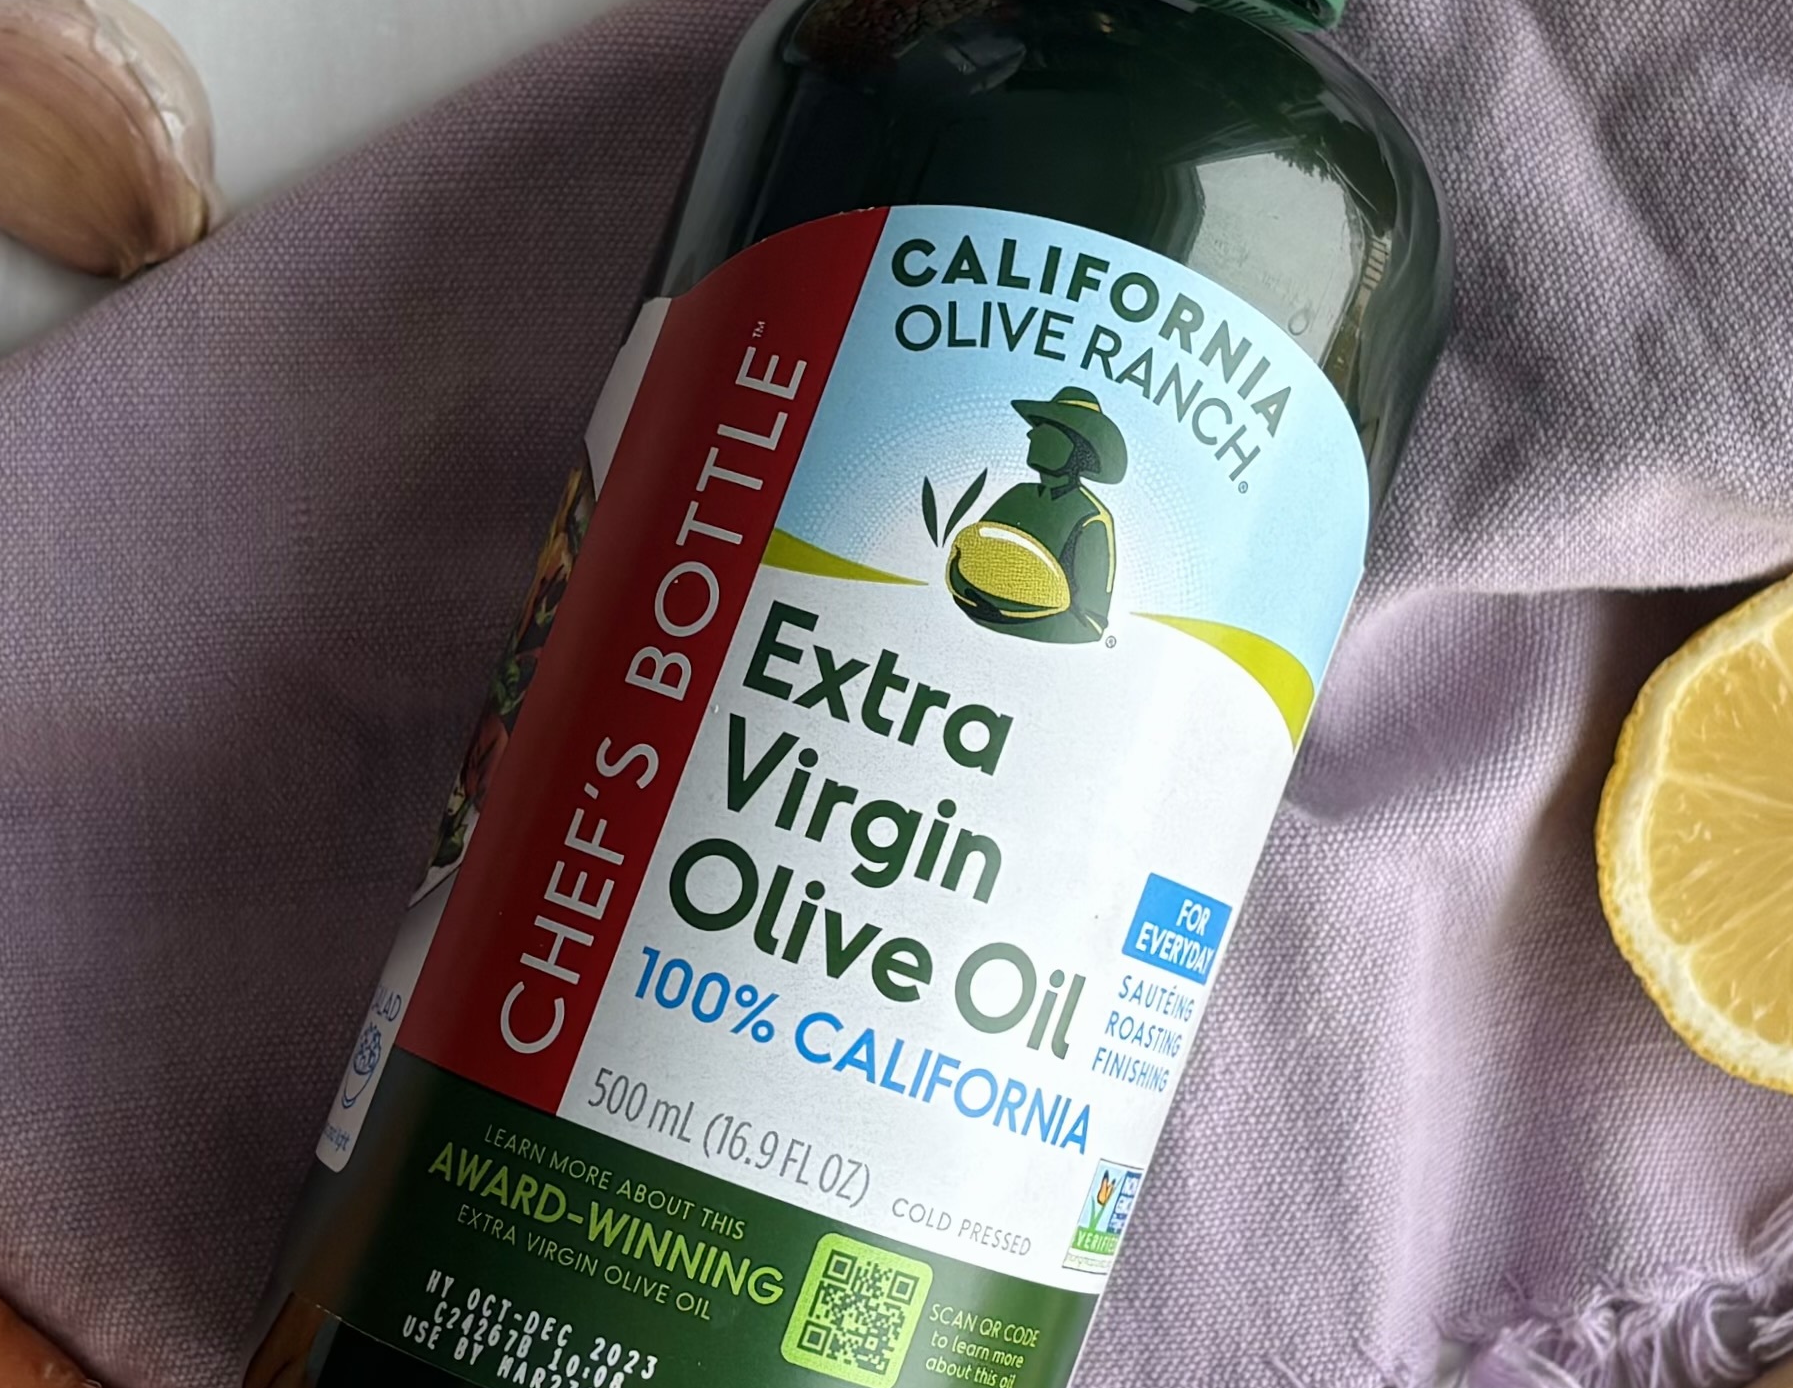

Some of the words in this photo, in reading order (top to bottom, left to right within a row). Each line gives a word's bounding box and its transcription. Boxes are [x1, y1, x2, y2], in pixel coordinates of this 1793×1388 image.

[891, 235, 1291, 437] CALIFORNIA
[895, 301, 1074, 361] OLIVE
[1080, 324, 1261, 482] RANCH
[743, 600, 1014, 776] Extra
[727, 712, 1002, 904] Virgin
[500, 737, 659, 1054] CHEF'S
[1176, 899, 1210, 936] FOR
[669, 838, 933, 1002] Olive
[954, 942, 1086, 1059] Oil
[1136, 921, 1214, 975] EVERYDAY
[1105, 1011, 1182, 1058] ROASTING
[1119, 975, 1194, 1022] SAUTÉING
[634, 946, 780, 1043] 100%
[795, 1012, 1090, 1154] CALIFORNIA
[1092, 1047, 1169, 1092] FINISHING
[485, 1124, 546, 1164] LEARN
[550, 1150, 612, 1190] MORE
[616, 1179, 694, 1220] ABOUT
[703, 1208, 746, 1240] THIS
[588, 1068, 648, 1121] 500
[648, 1098, 695, 1143] mL
[703, 1112, 778, 1169] (16.9
[780, 1138, 810, 1187] FL
[819, 1153, 871, 1208] OZ)
[428, 1142, 784, 1304] AWARD-WINNING
[458, 1205, 517, 1246] EXTRA
[527, 1232, 598, 1277] VIRGIN
[605, 1265, 667, 1303] OLIVE
[675, 1293, 712, 1320] OIL
[892, 1198, 951, 1231] COLD
[958, 1219, 1031, 1256] PRESSED
[403, 1315, 440, 1350] USE
[453, 1336, 484, 1365] BY
[434, 1301, 531, 1358] C24267B
[467, 1288, 573, 1347] OCT-DEC
[590, 1337, 658, 1379] 2023
[926, 1355, 972, 1380] about
[974, 1367, 996, 1386] this
[929, 1304, 978, 1332] SCAN
[980, 1318, 1002, 1339] QR
[1004, 1324, 1040, 1347] CODE
[931, 1331, 948, 1348] to
[952, 1335, 989, 1361] learn
[992, 1349, 1024, 1368] more
